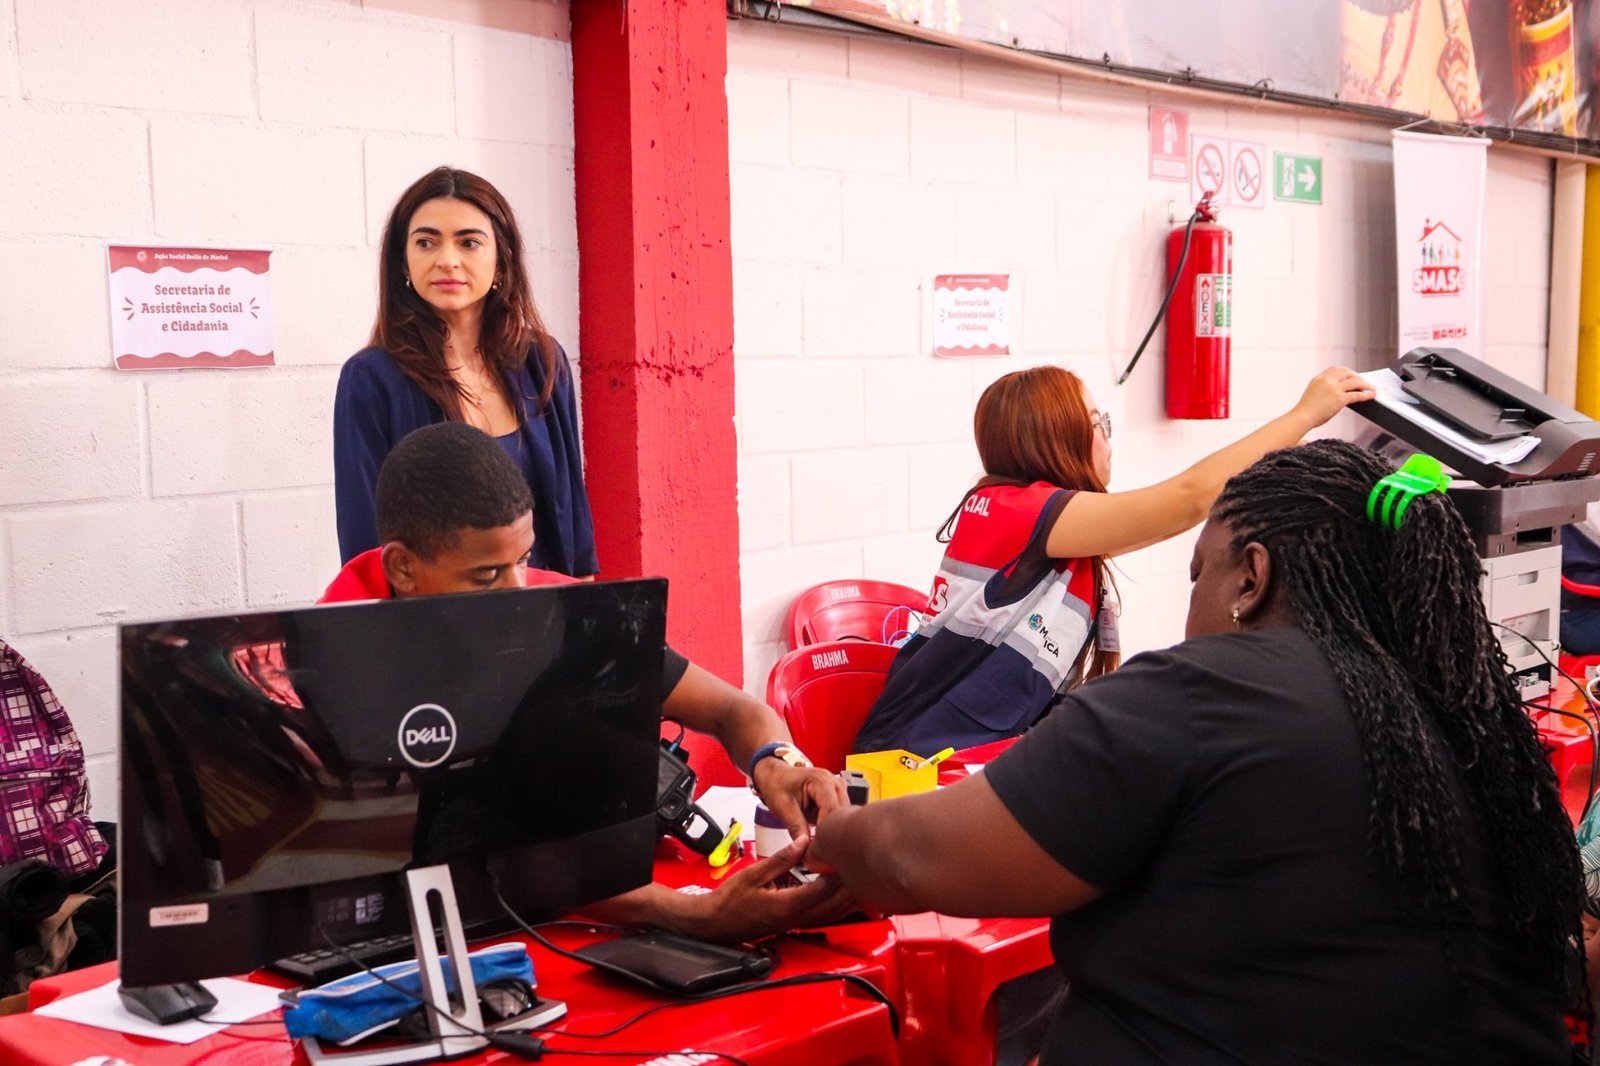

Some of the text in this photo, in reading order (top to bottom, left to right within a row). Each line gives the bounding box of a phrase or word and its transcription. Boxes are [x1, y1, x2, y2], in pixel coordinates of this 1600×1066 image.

[155, 284, 231, 296] Secretaria de
[141, 302, 243, 314] Assistência Social
[161, 320, 229, 332] e Cidadania
[830, 585, 861, 600] BRAHMA
[812, 649, 849, 670] BRAHMA
[405, 725, 451, 746] DELL
